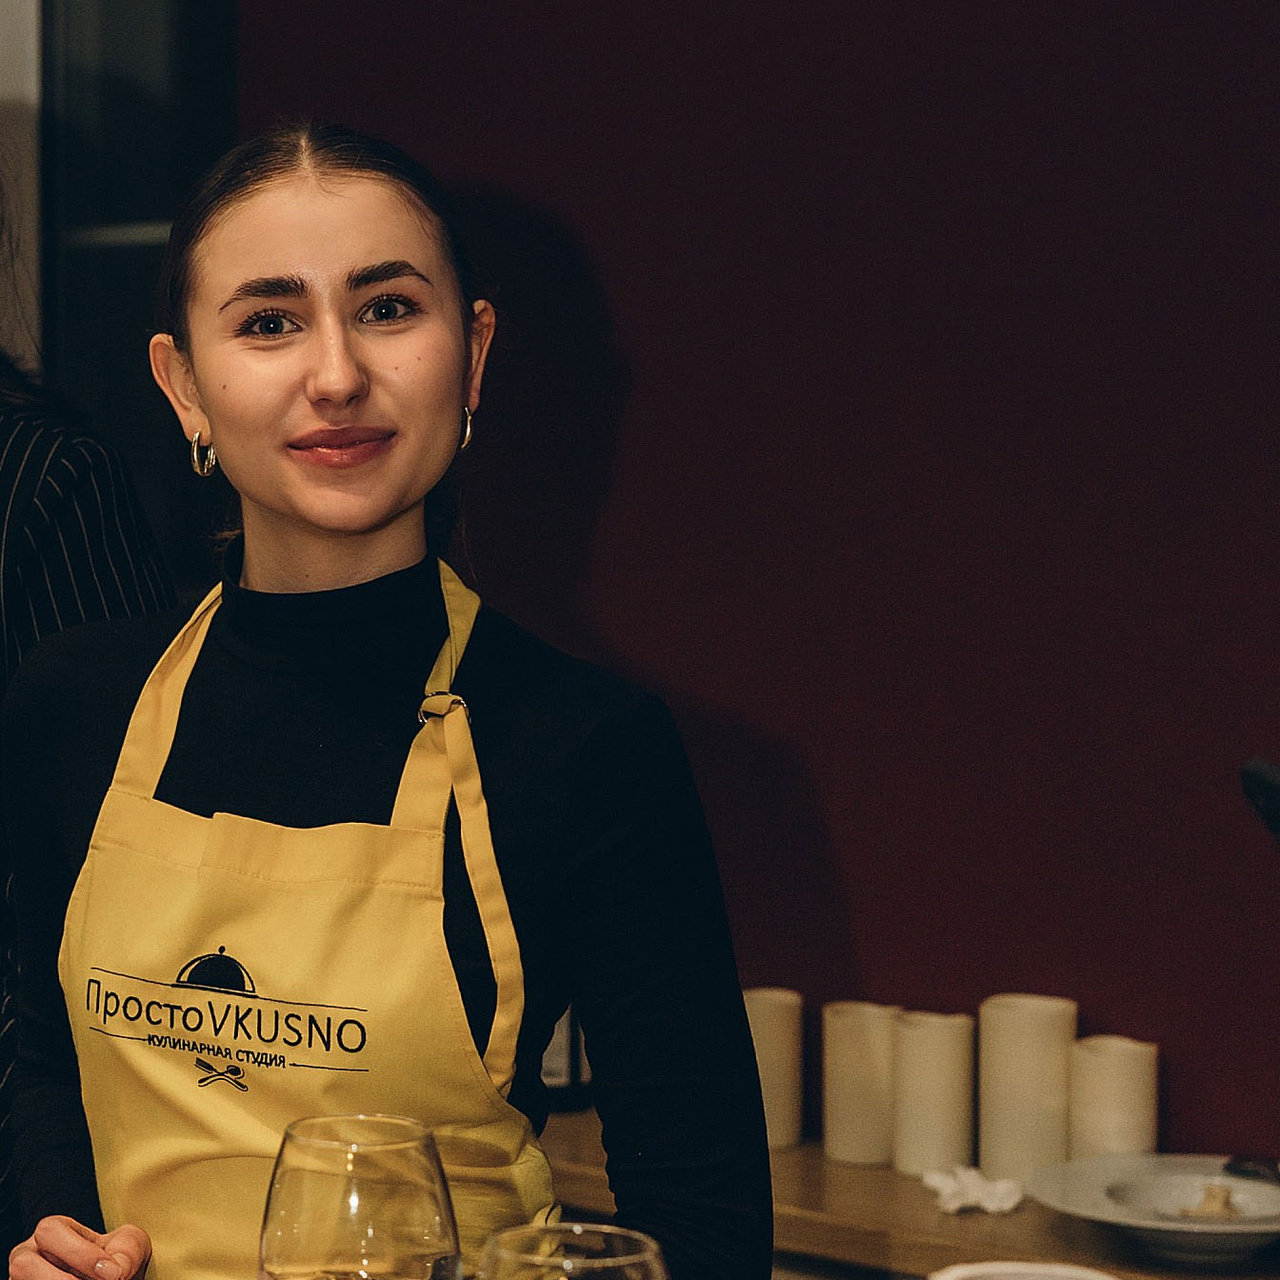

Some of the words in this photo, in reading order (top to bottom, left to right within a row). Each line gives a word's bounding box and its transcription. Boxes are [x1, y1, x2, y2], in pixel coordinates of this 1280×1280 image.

[86, 979, 367, 1053] ПростоVKUSNO
[147, 1034, 233, 1060] КУЛИНАРНАЯ
[236, 1049, 286, 1068] СТУДИЯ
